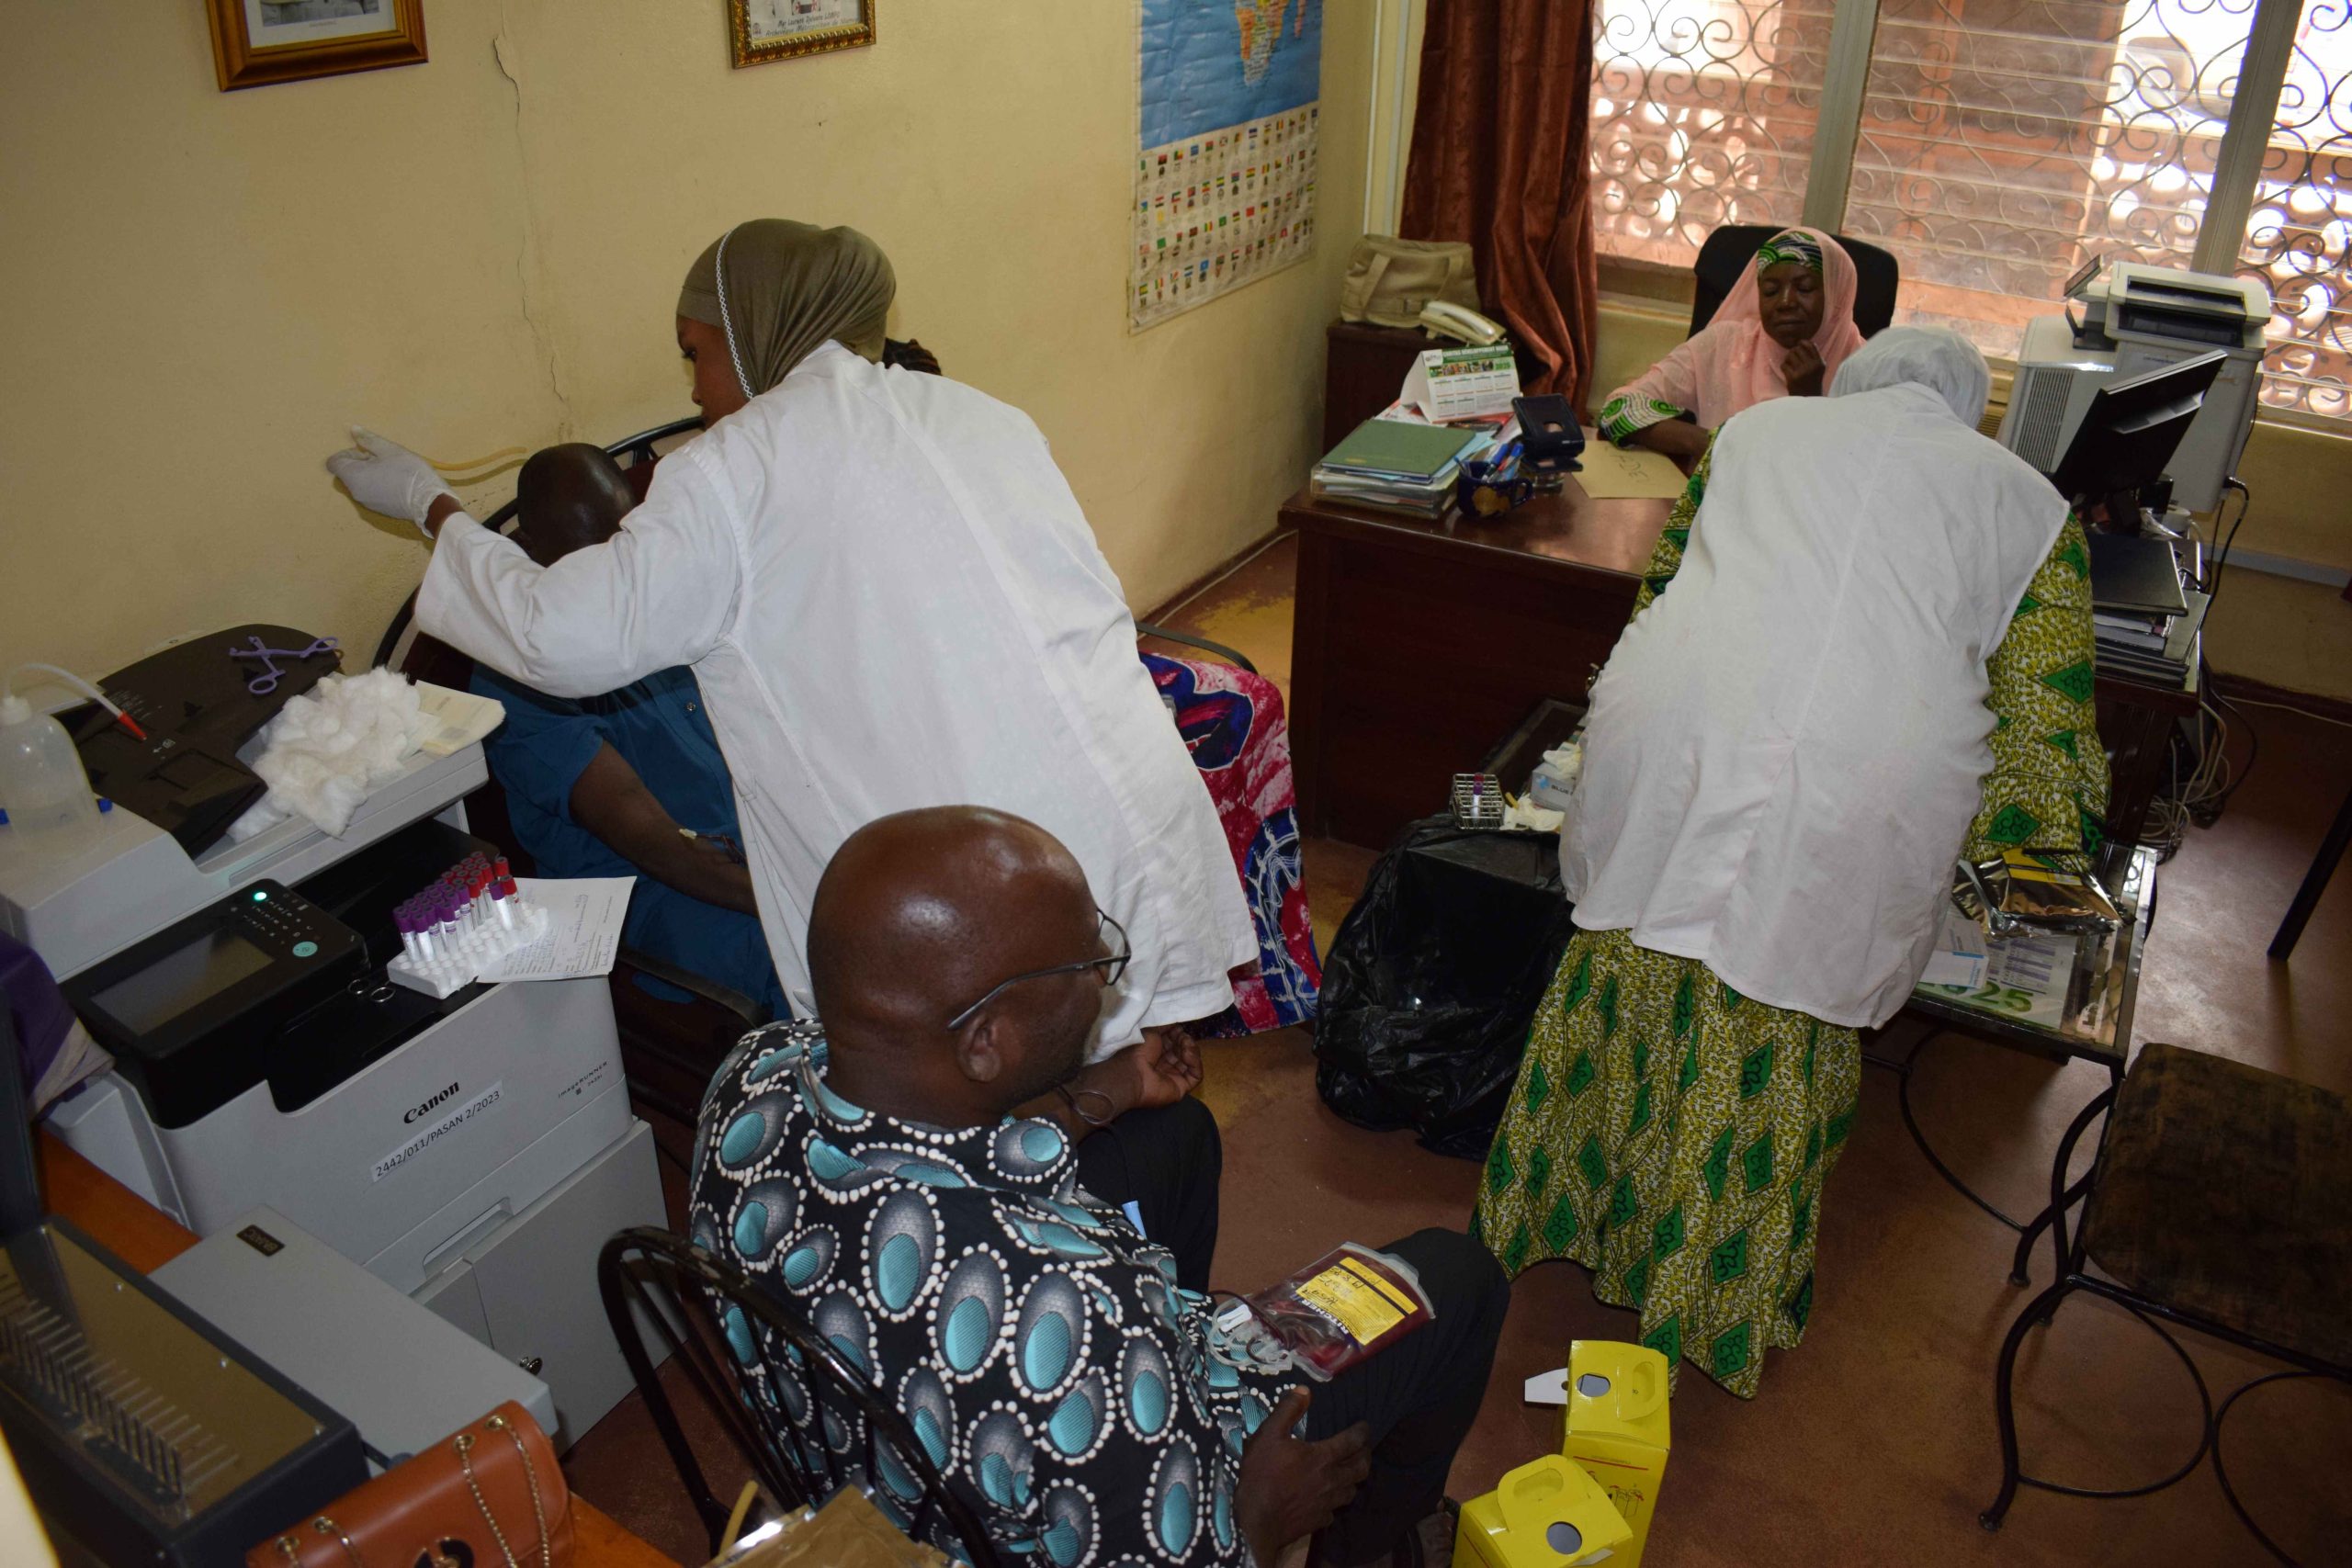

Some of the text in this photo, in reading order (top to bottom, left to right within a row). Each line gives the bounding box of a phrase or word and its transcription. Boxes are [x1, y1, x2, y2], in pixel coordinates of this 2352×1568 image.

[376, 1090, 500, 1177] 2442/011/PASAN 2/2023
[403, 1081, 459, 1124] Canon
